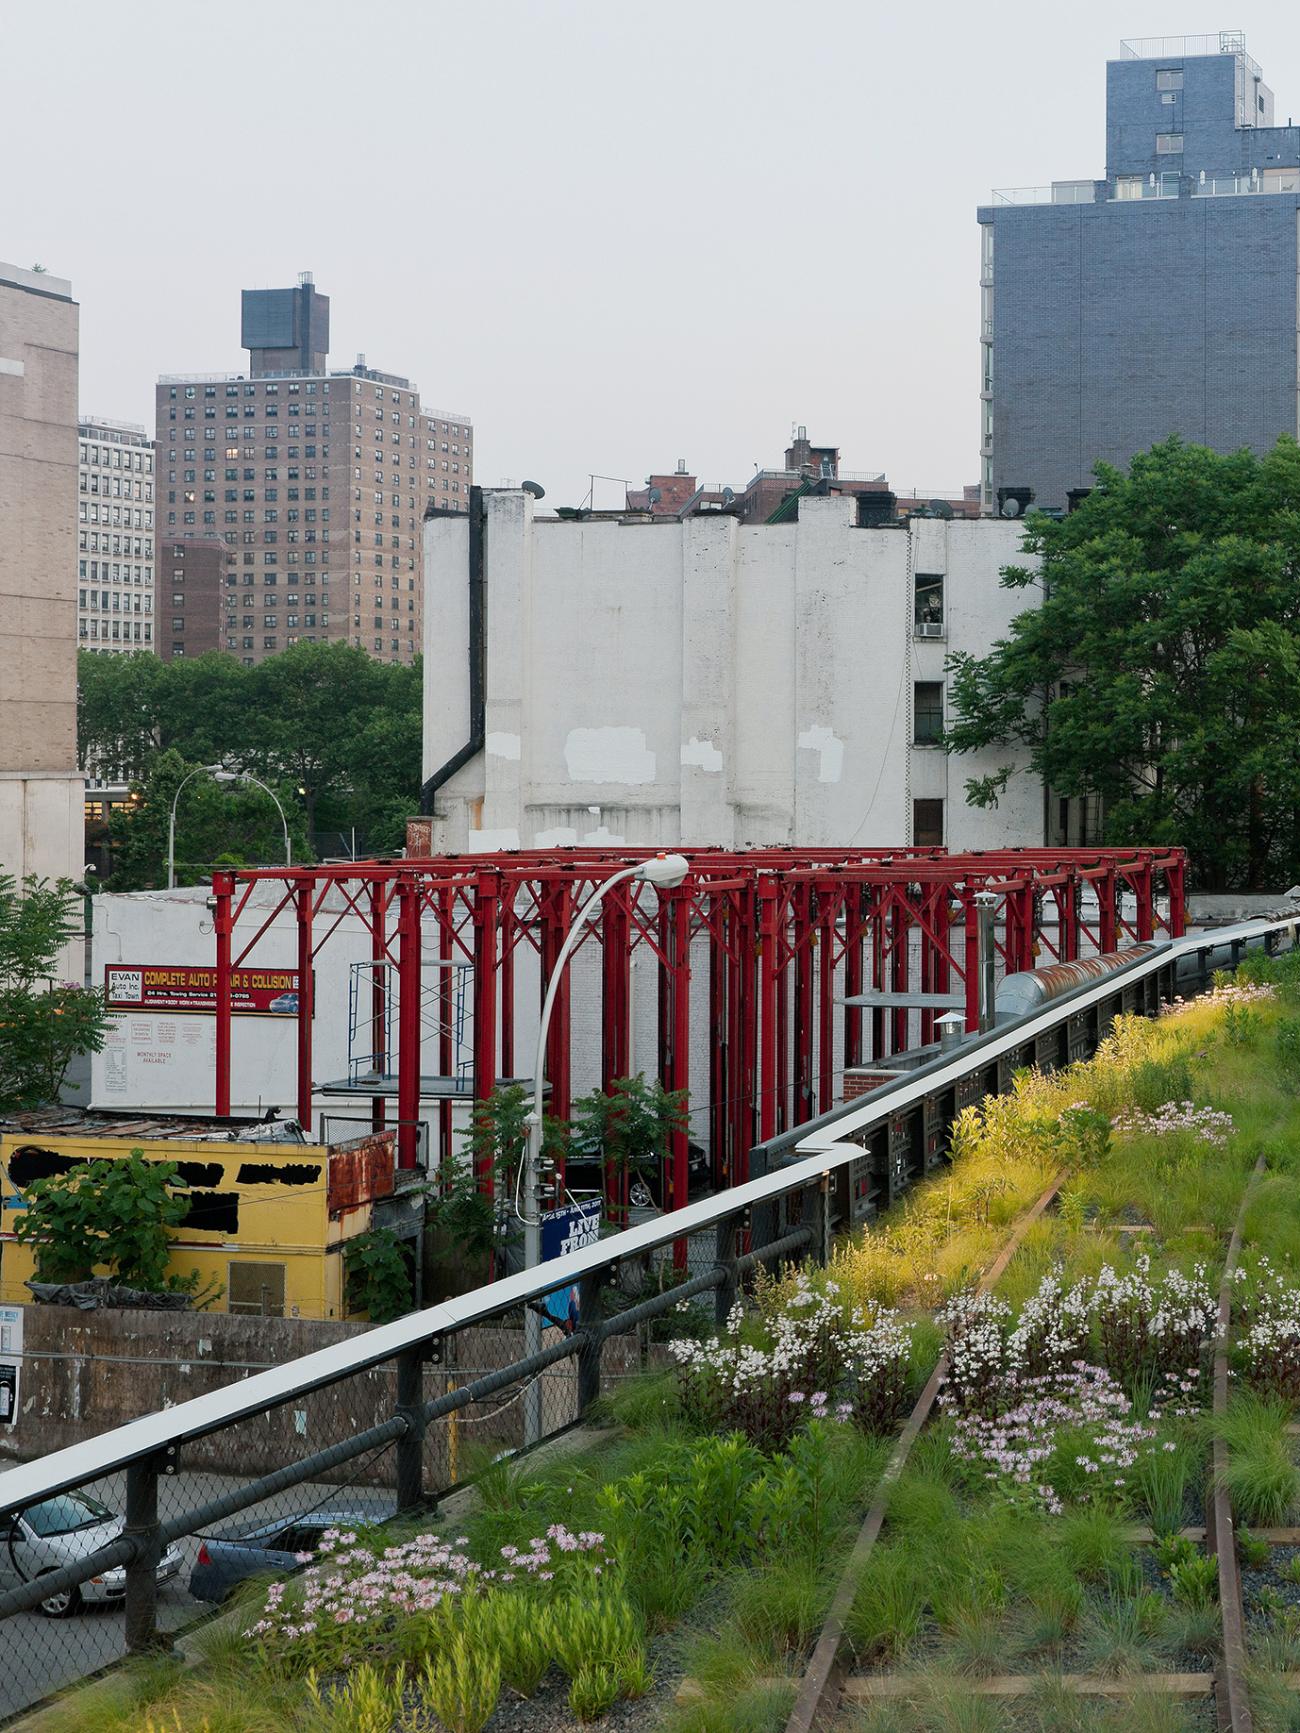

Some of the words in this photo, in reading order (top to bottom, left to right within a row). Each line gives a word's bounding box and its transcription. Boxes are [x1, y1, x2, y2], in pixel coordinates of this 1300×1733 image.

[111, 973, 140, 981] EVAN
[144, 971, 186, 986] COMPLETE
[189, 973, 210, 987] AUTO
[243, 974, 249, 989] &
[252, 975, 291, 989] COLLISION
[112, 982, 127, 990] Auto
[125, 992, 140, 1000] Town
[569, 1213, 600, 1238] LIVE
